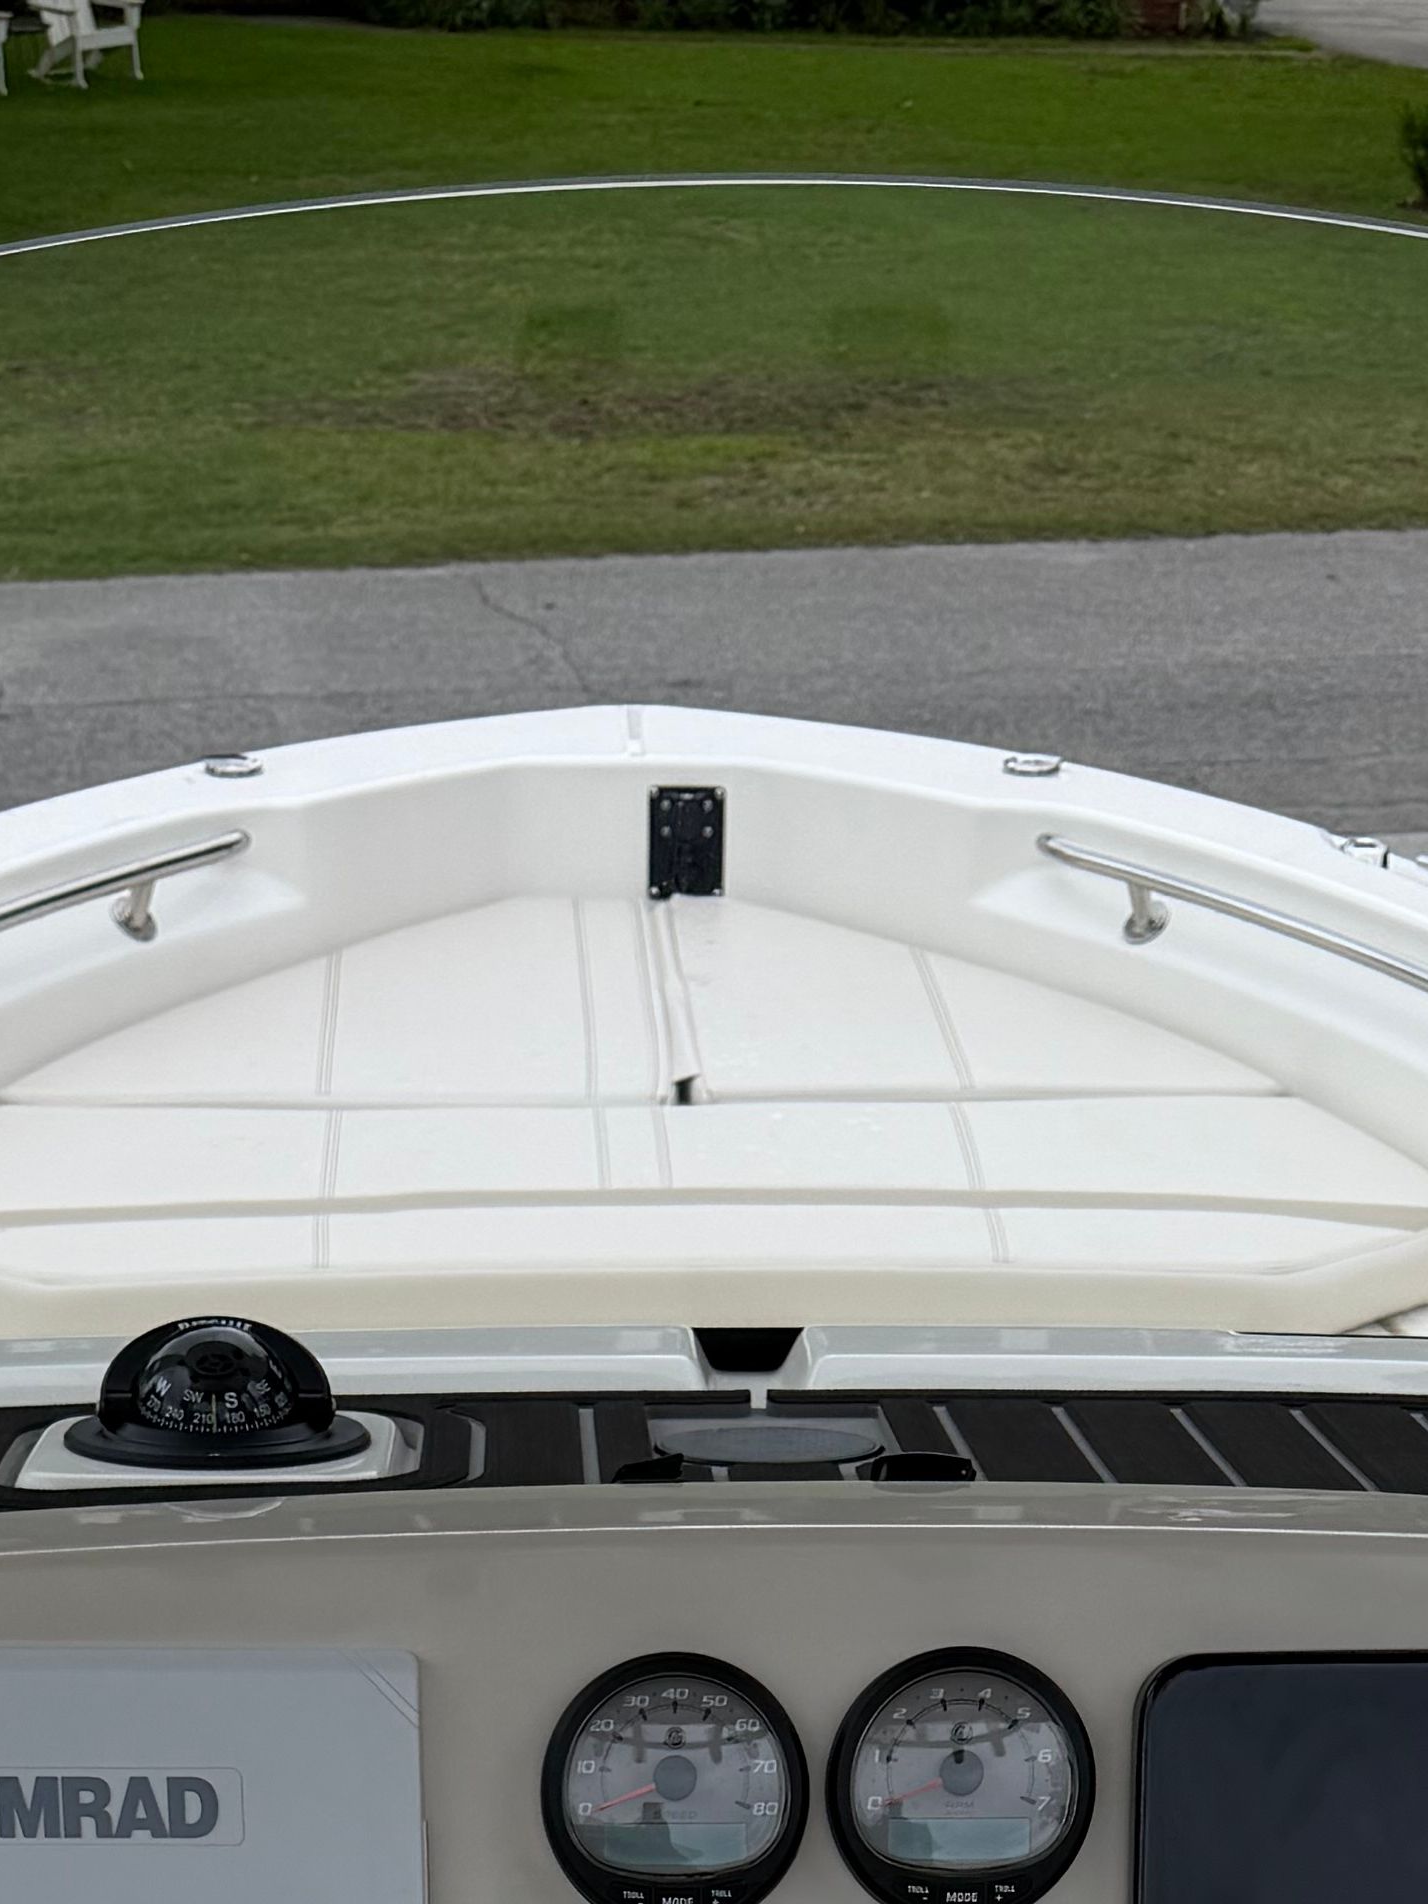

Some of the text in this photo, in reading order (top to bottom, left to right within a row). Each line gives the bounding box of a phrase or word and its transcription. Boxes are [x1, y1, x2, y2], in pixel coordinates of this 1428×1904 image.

[183, 1389, 204, 1403] SW
[224, 1392, 238, 1408] S
[193, 1412, 214, 1424] 210
[225, 1411, 245, 1423] 180
[661, 1688, 689, 1699] 40
[930, 1688, 944, 1698] 3
[978, 1688, 992, 1698] 4
[623, 1695, 649, 1707] 30
[701, 1695, 727, 1707] 50
[892, 1708, 908, 1719] 2
[1017, 1707, 1031, 1719] 5
[590, 1719, 614, 1732] 20
[735, 1719, 760, 1732] 60
[874, 1749, 880, 1763] 1
[1038, 1748, 1052, 1763] 6
[577, 1760, 595, 1774] 10
[753, 1759, 777, 1774] 70
[578, 1802, 592, 1816] 0
[753, 1802, 778, 1815] 80
[1037, 1796, 1051, 1810] 7
[946, 1892, 978, 1903] MODE
